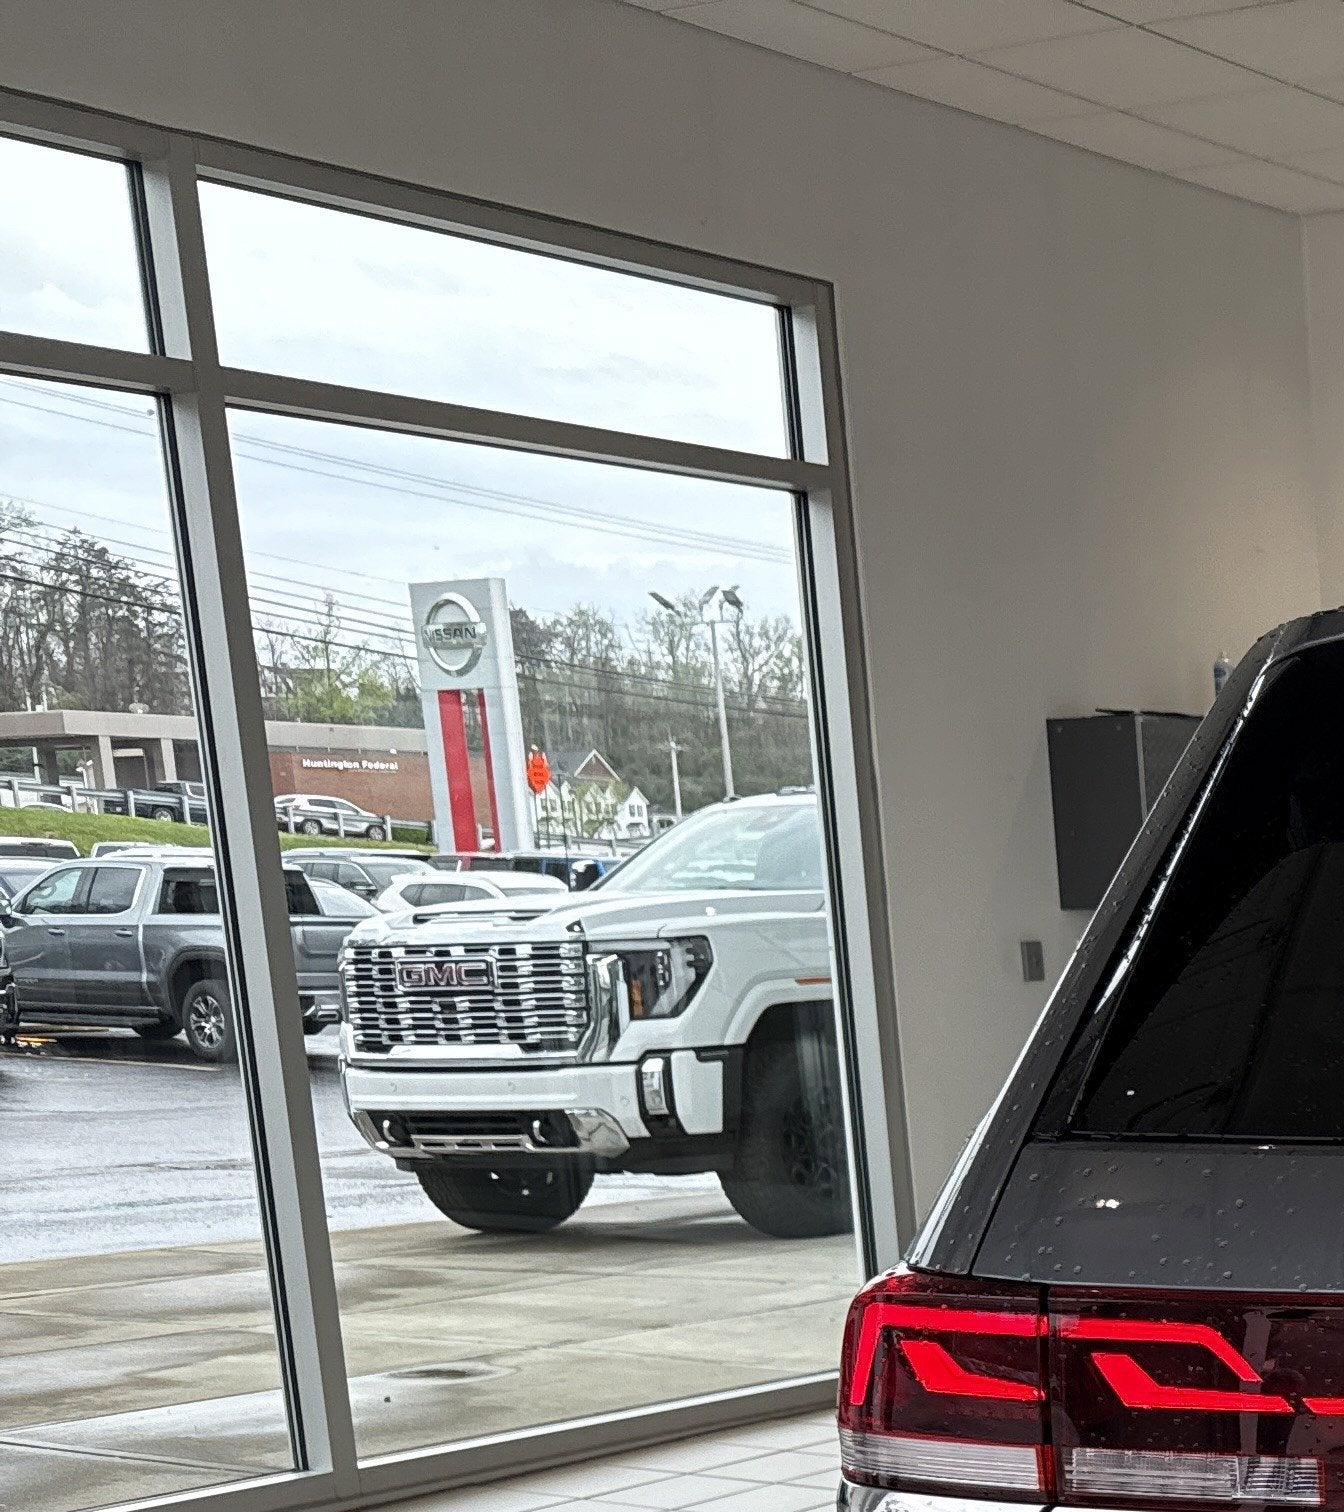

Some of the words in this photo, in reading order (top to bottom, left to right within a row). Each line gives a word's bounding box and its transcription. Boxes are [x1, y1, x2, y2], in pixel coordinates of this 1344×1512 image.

[424, 626, 477, 643] NISSAN
[302, 759, 360, 771] Huntington
[361, 760, 399, 771] Federal
[400, 962, 488, 987] GMC
